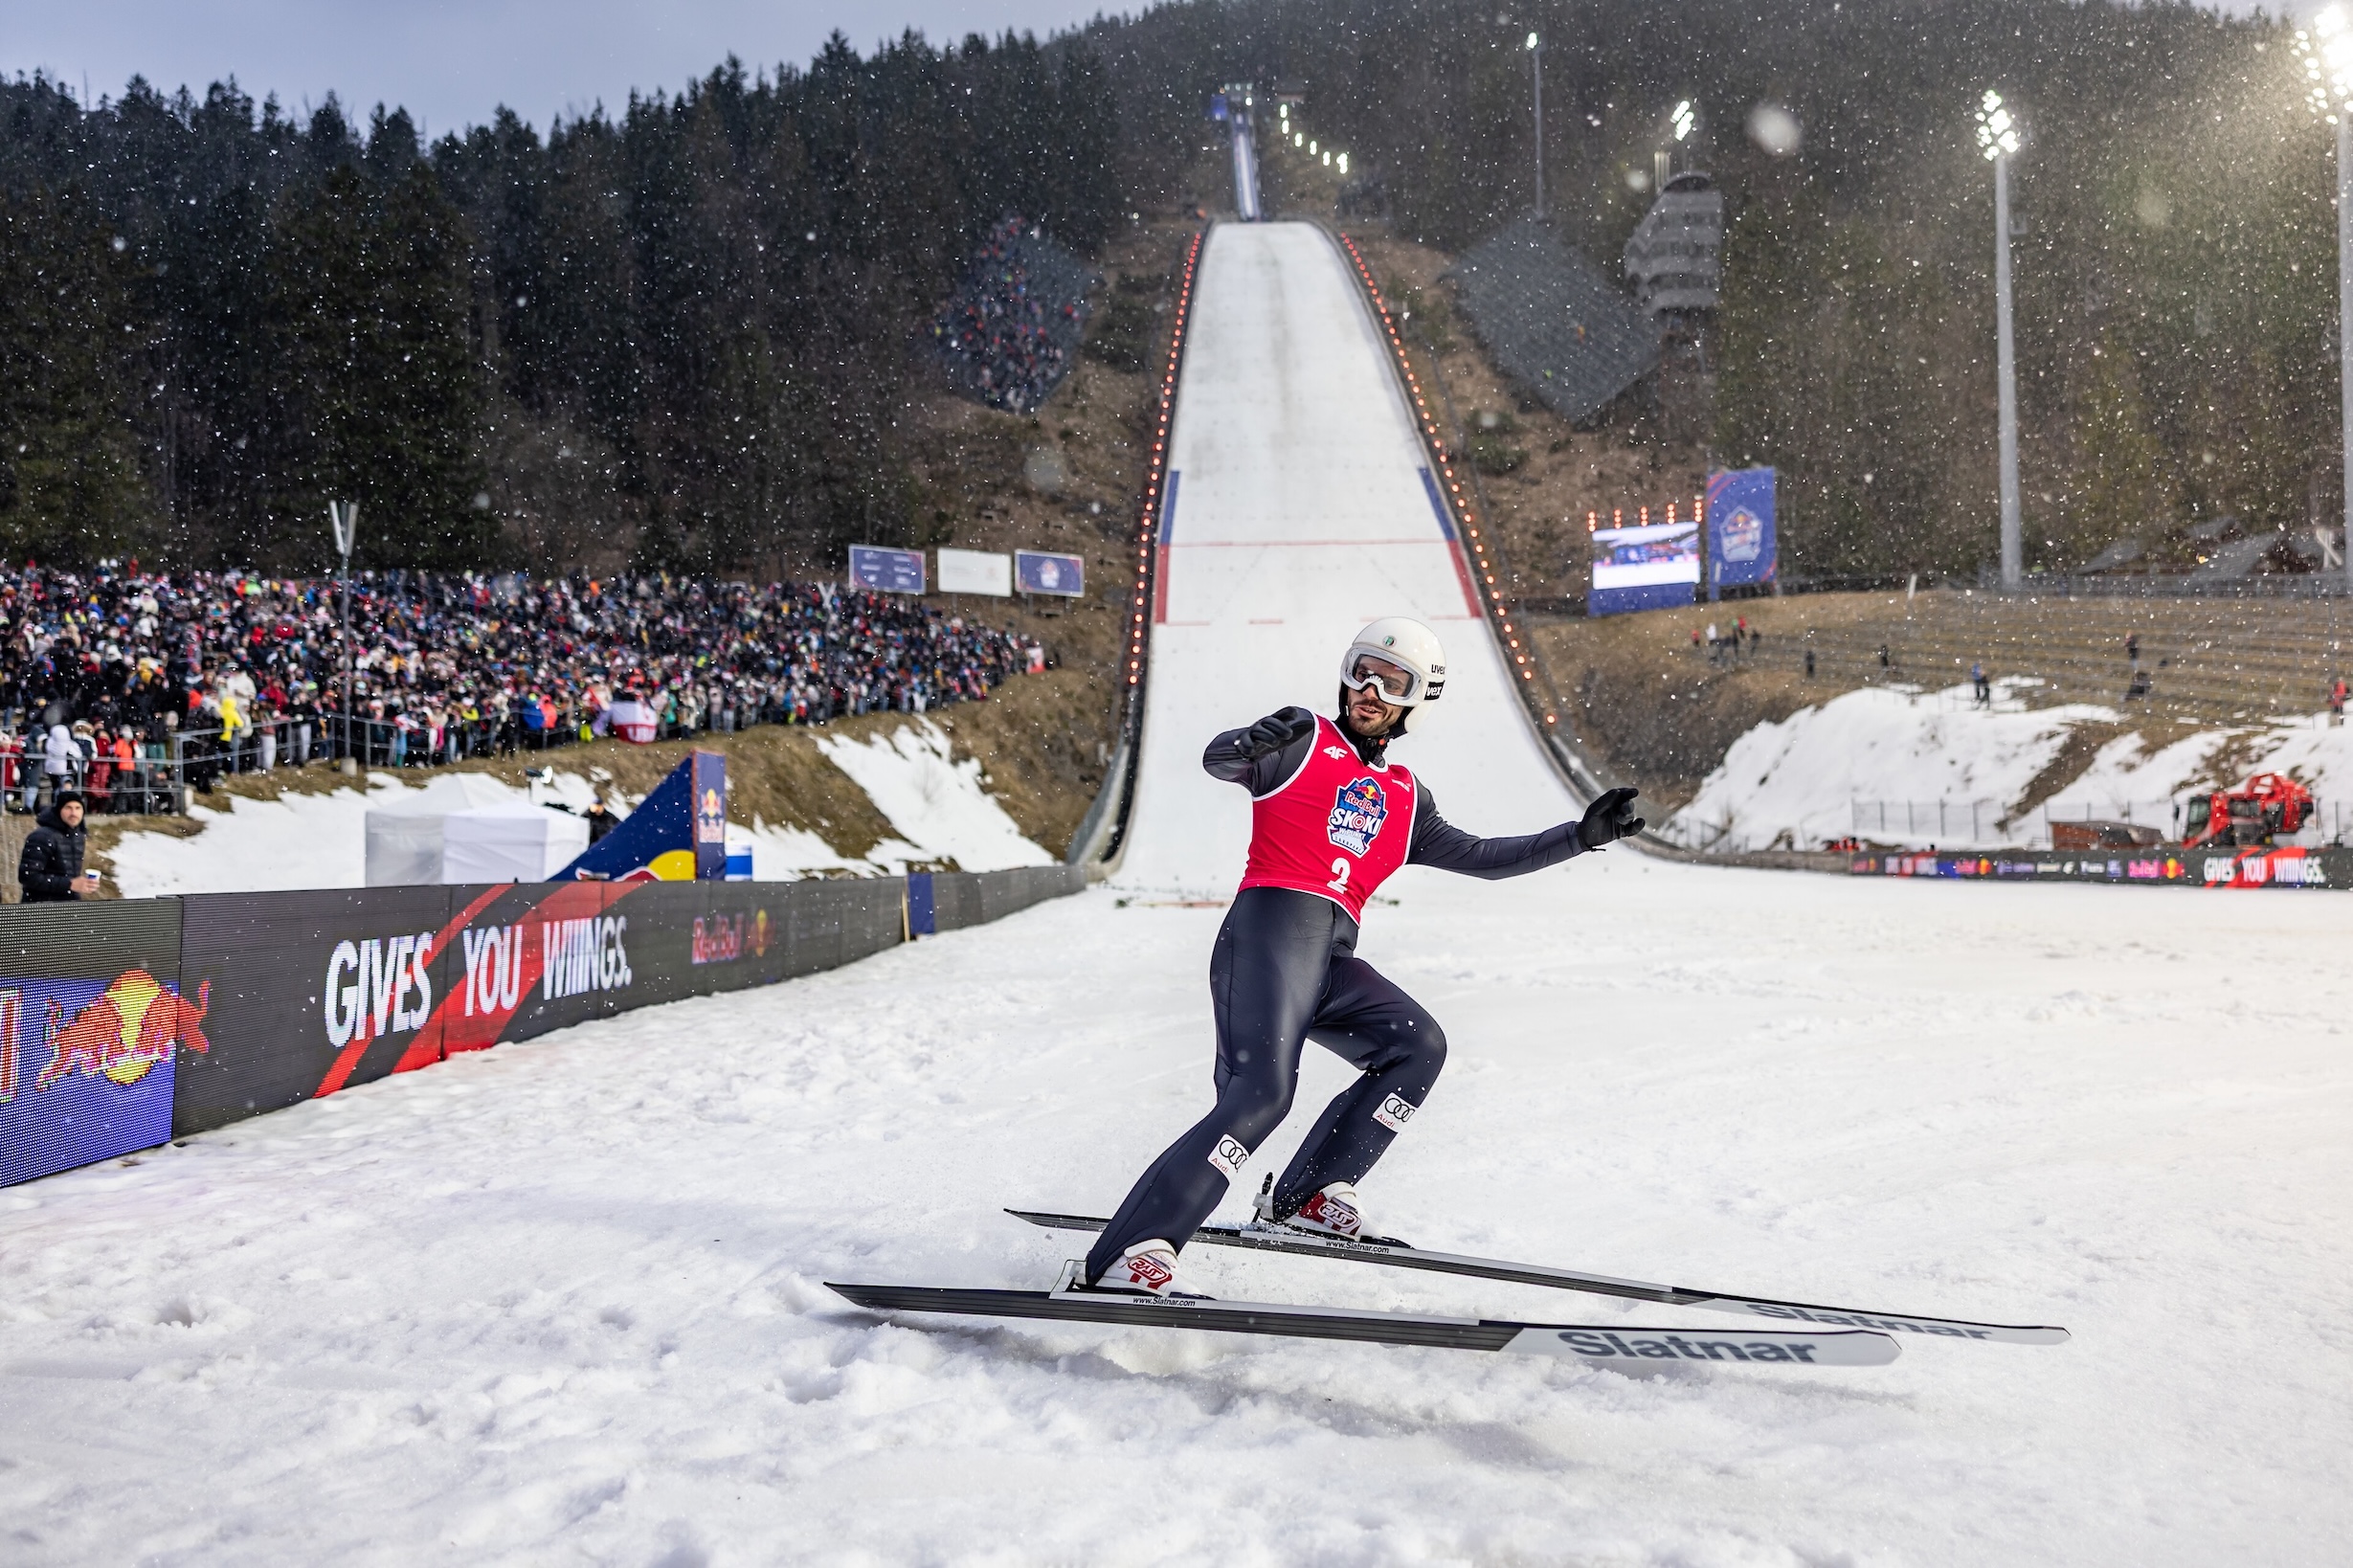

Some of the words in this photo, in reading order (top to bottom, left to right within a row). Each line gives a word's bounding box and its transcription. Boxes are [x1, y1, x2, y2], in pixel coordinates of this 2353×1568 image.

[1323, 746, 1348, 760] 4F
[1344, 792, 1365, 809] Red
[1363, 798, 1381, 817] Bull
[1330, 808, 1382, 835] SKOKI
[1327, 857, 1351, 894] 2
[2204, 857, 2235, 883] GIVES
[2242, 857, 2267, 883] YOU
[324, 930, 433, 1048] GIVES
[462, 925, 524, 1018] YOU
[542, 915, 633, 1000] WIIINGS.
[1376, 1113, 1396, 1128] Audi
[1210, 1157, 1229, 1174] Audi
[1325, 1241, 1390, 1254] www.Slatnar.com
[1132, 1296, 1196, 1308] www.Slatnar.com
[1745, 1303, 1992, 1340] Slatnar
[1557, 1331, 1817, 1363] Slatnar
